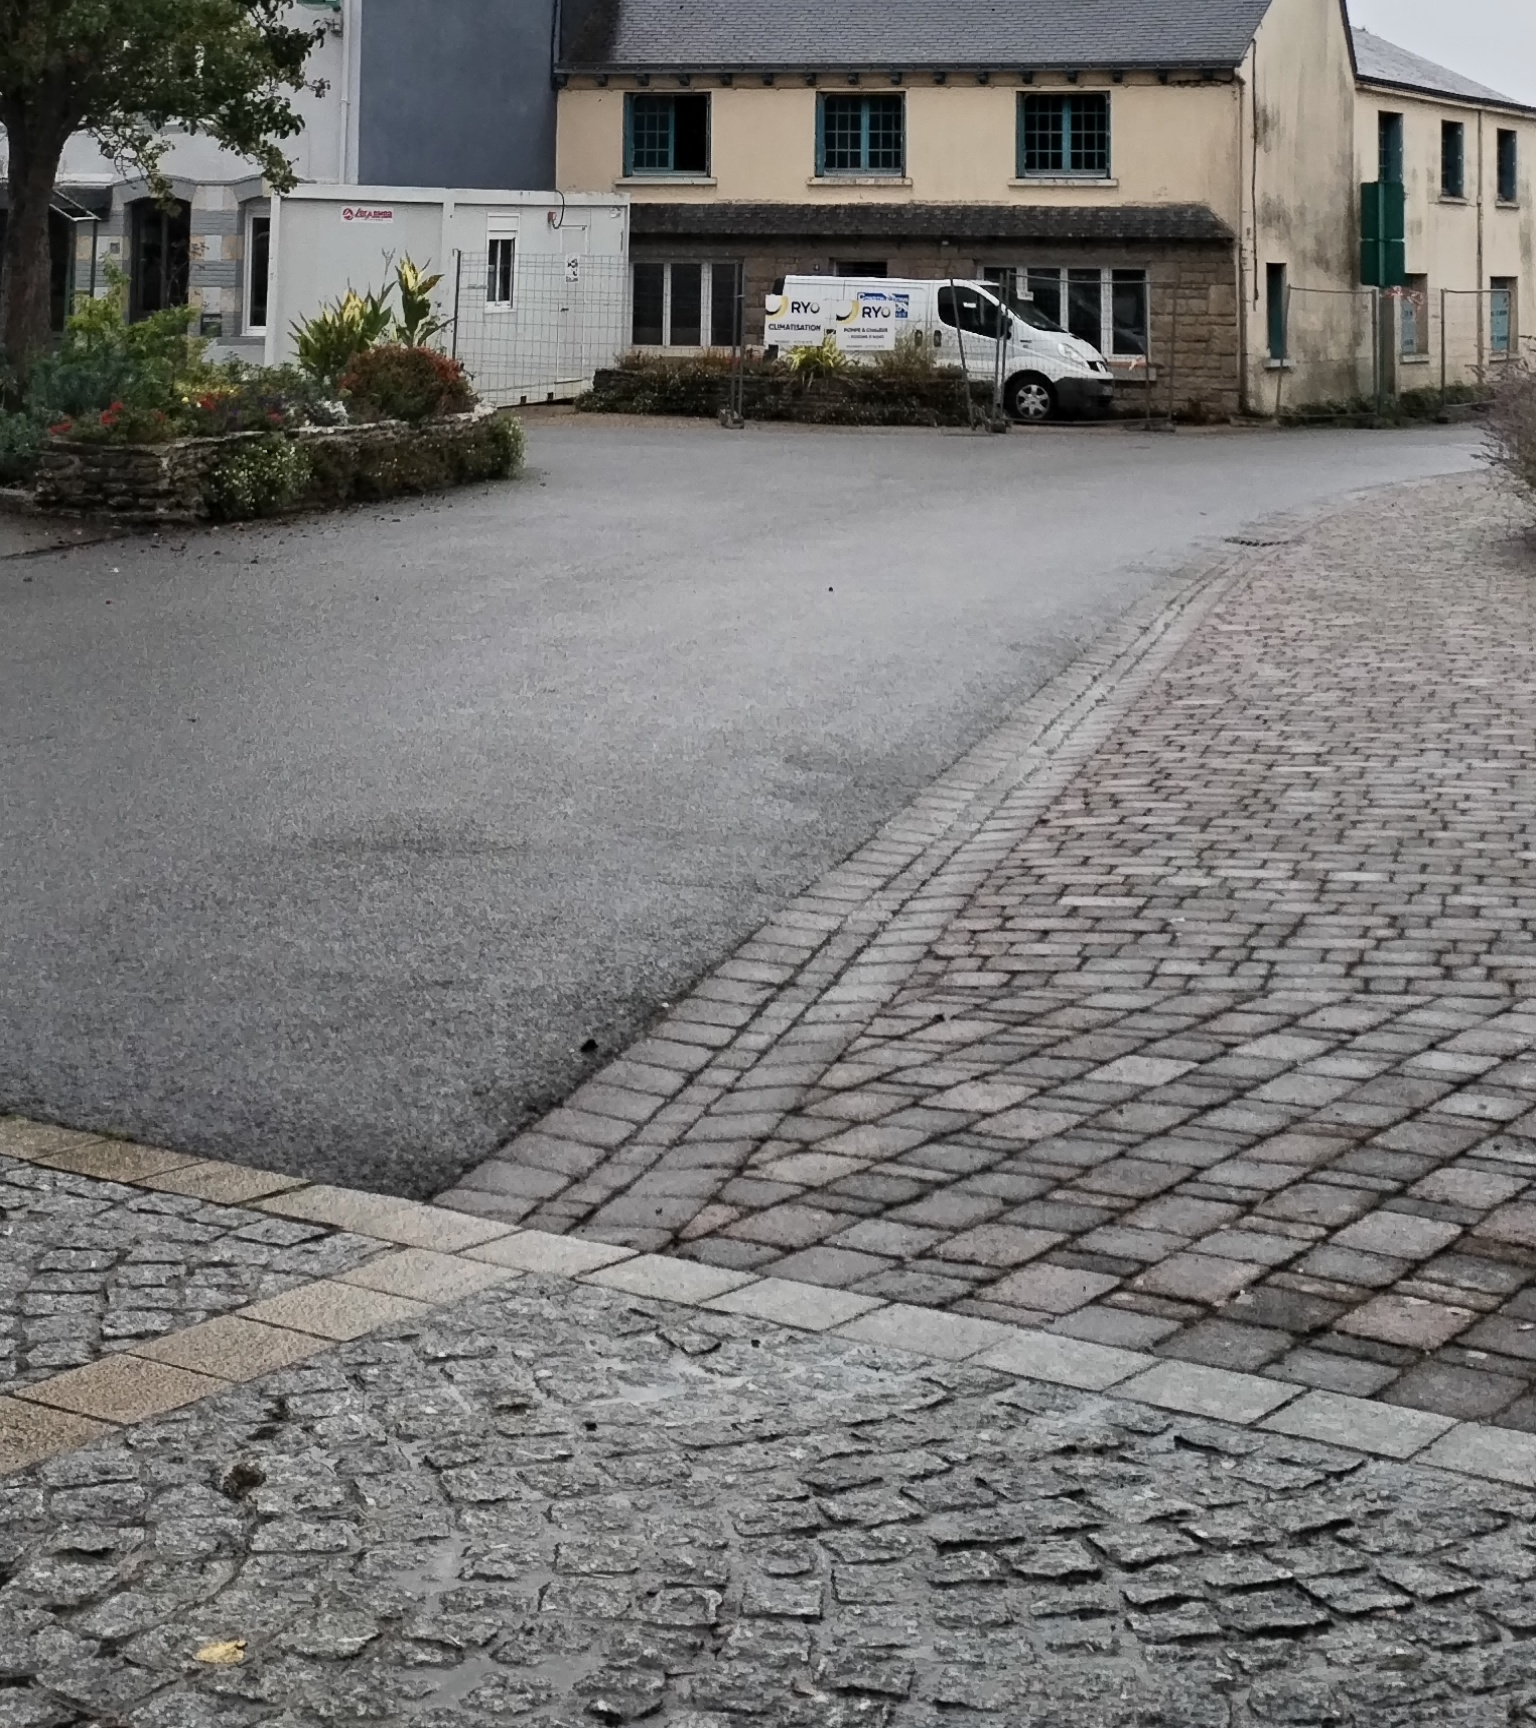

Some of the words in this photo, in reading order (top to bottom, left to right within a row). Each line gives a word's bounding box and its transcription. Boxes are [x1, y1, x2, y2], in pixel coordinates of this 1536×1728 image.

[791, 301, 820, 314] RYO
[862, 306, 891, 318] RYO
[768, 323, 821, 332] CLIMATISATION
